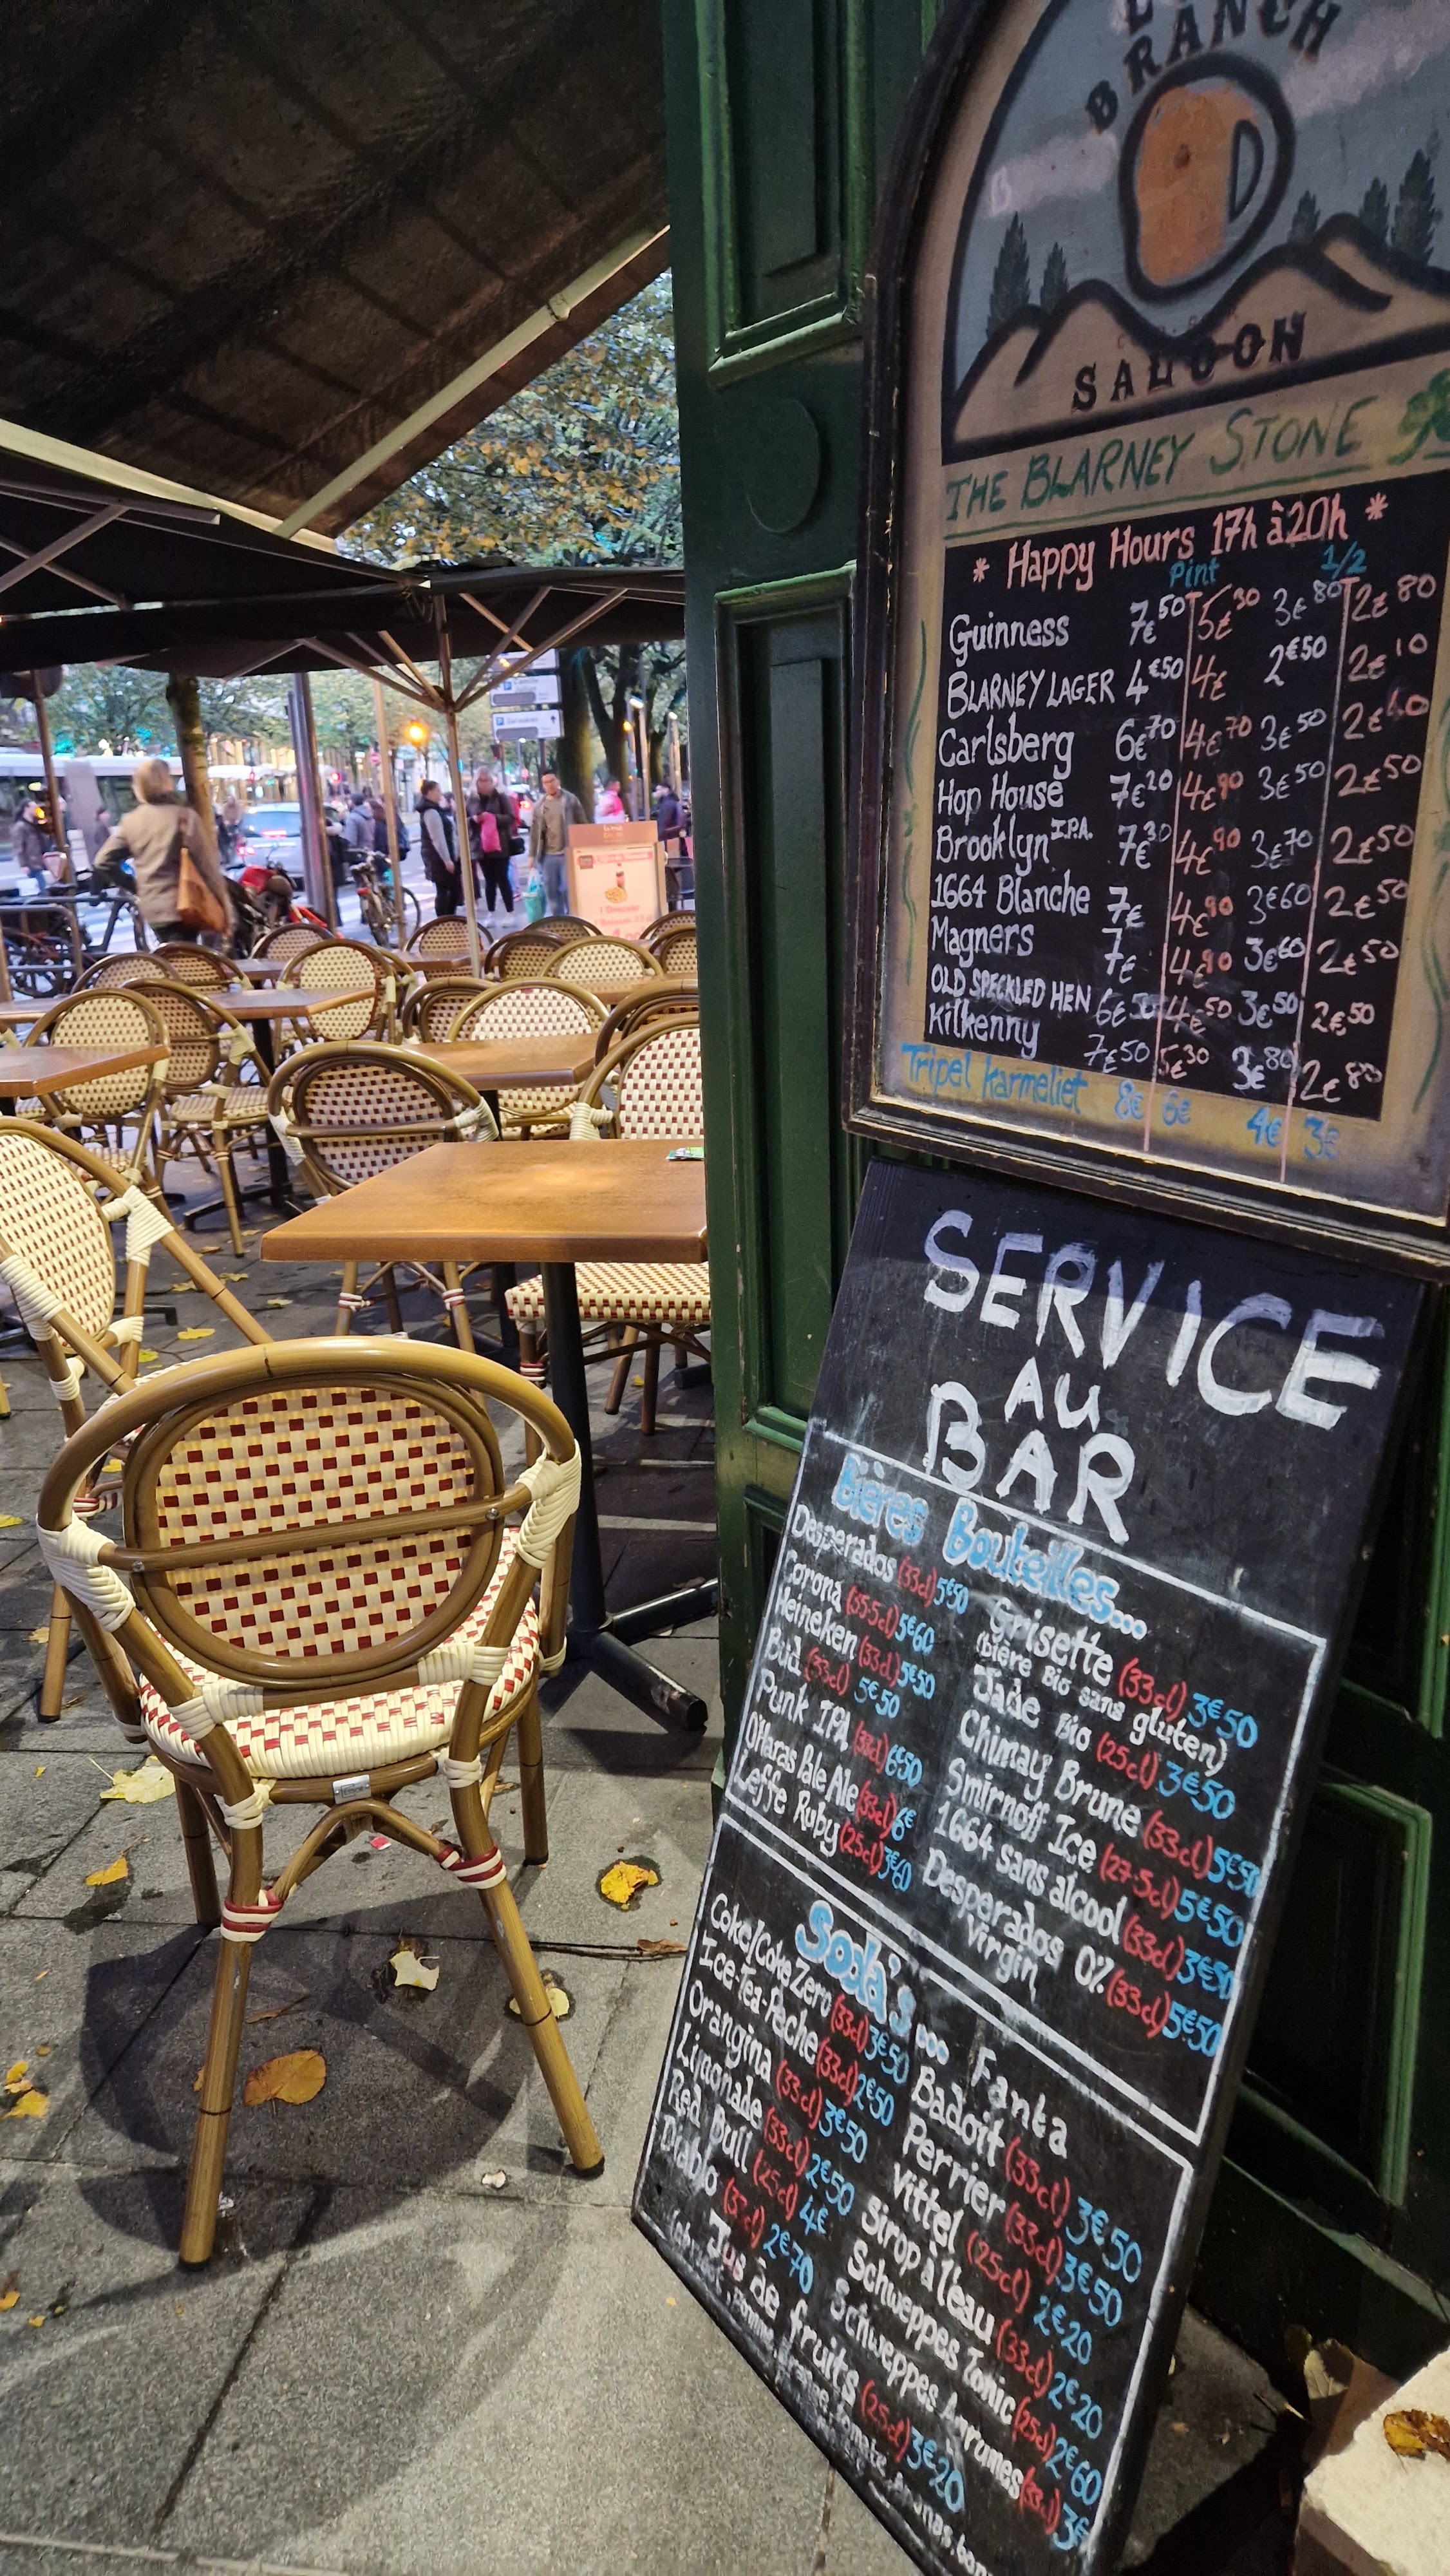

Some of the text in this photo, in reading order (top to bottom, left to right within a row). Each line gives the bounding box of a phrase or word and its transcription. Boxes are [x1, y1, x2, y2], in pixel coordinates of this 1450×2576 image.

[945, 395, 1378, 521] THE BLARNEY STONE
[1006, 540, 1095, 592] Happy
[1109, 524, 1195, 569] Hours
[1210, 506, 1257, 556] 17h
[1169, 541, 1367, 589] Pint 1/2
[949, 611, 1069, 667] Guinness
[947, 669, 1046, 719] BLARNEY
[1046, 668, 1116, 708] LAGER
[938, 711, 1075, 781] Carlsberg
[937, 779, 982, 826] Hop
[990, 770, 1064, 811] House
[936, 813, 1050, 876] Brooklyn
[930, 873, 987, 909] 1664
[996, 869, 1091, 917] Blanche
[931, 914, 1034, 968] Magners
[929, 998, 1040, 1060] Kilkenny
[930, 963, 966, 998] OLD
[969, 968, 1047, 1009] SPECKLED
[1050, 980, 1092, 1014] HEN
[901, 1042, 972, 1096] Tripel
[923, 1208, 1387, 1432] SERVICE
[923, 1381, 1136, 1546] BAR
[775, 1586, 858, 1660] Heineken
[784, 1549, 842, 1613] Corona
[764, 1627, 802, 1676] Bud
[990, 1597, 1114, 1687] Grisette
[756, 1668, 809, 1725] Punk
[973, 1663, 1040, 1729] Jade
[1055, 1712, 1092, 1752] Bio
[1042, 1665, 1072, 1696] Bio
[1078, 1686, 1125, 1721] sans
[1129, 1707, 1227, 1777] gluten)
[734, 1749, 787, 1815] Leffe
[793, 1790, 840, 1857] Ruby
[797, 1744, 827, 1792] Pale
[825, 1763, 859, 1812] Ale
[946, 1757, 1050, 1842] Smirnoff
[1048, 1814, 1097, 1873] Ice
[959, 1709, 1053, 1801] Chimay
[1055, 1759, 1141, 1837] Brune
[923, 1847, 1064, 1971] Desperados
[934, 1801, 995, 1861] 1664
[996, 1844, 1049, 1896] sans
[1049, 1871, 1128, 1945] alcool
[790, 1958, 832, 2017] Zero
[967, 1913, 1039, 2003] Virgin
[1075, 1945, 1115, 1993] 0%
[677, 2022, 763, 2130] Limonade
[690, 1980, 771, 2084] Orangina
[668, 2069, 702, 2127] Red
[710, 2105, 753, 2174] Bull
[911, 2065, 1005, 2167] Badoit
[971, 2047, 1068, 2159] Fanta
[661, 2114, 718, 2197] Diablo
[903, 2112, 1006, 2222] Perrier
[894, 2163, 964, 2254] Vittel
[707, 2209, 746, 2282] Jus
[749, 2257, 780, 2320] de
[790, 2299, 859, 2408] fruits
[862, 2195, 921, 2277] Sirop
[937, 2259, 994, 2345] l'eau
[831, 2277, 939, 2412] Schweppes
[848, 2239, 959, 2371] Schweppes
[963, 2347, 1015, 2425] Tonic
